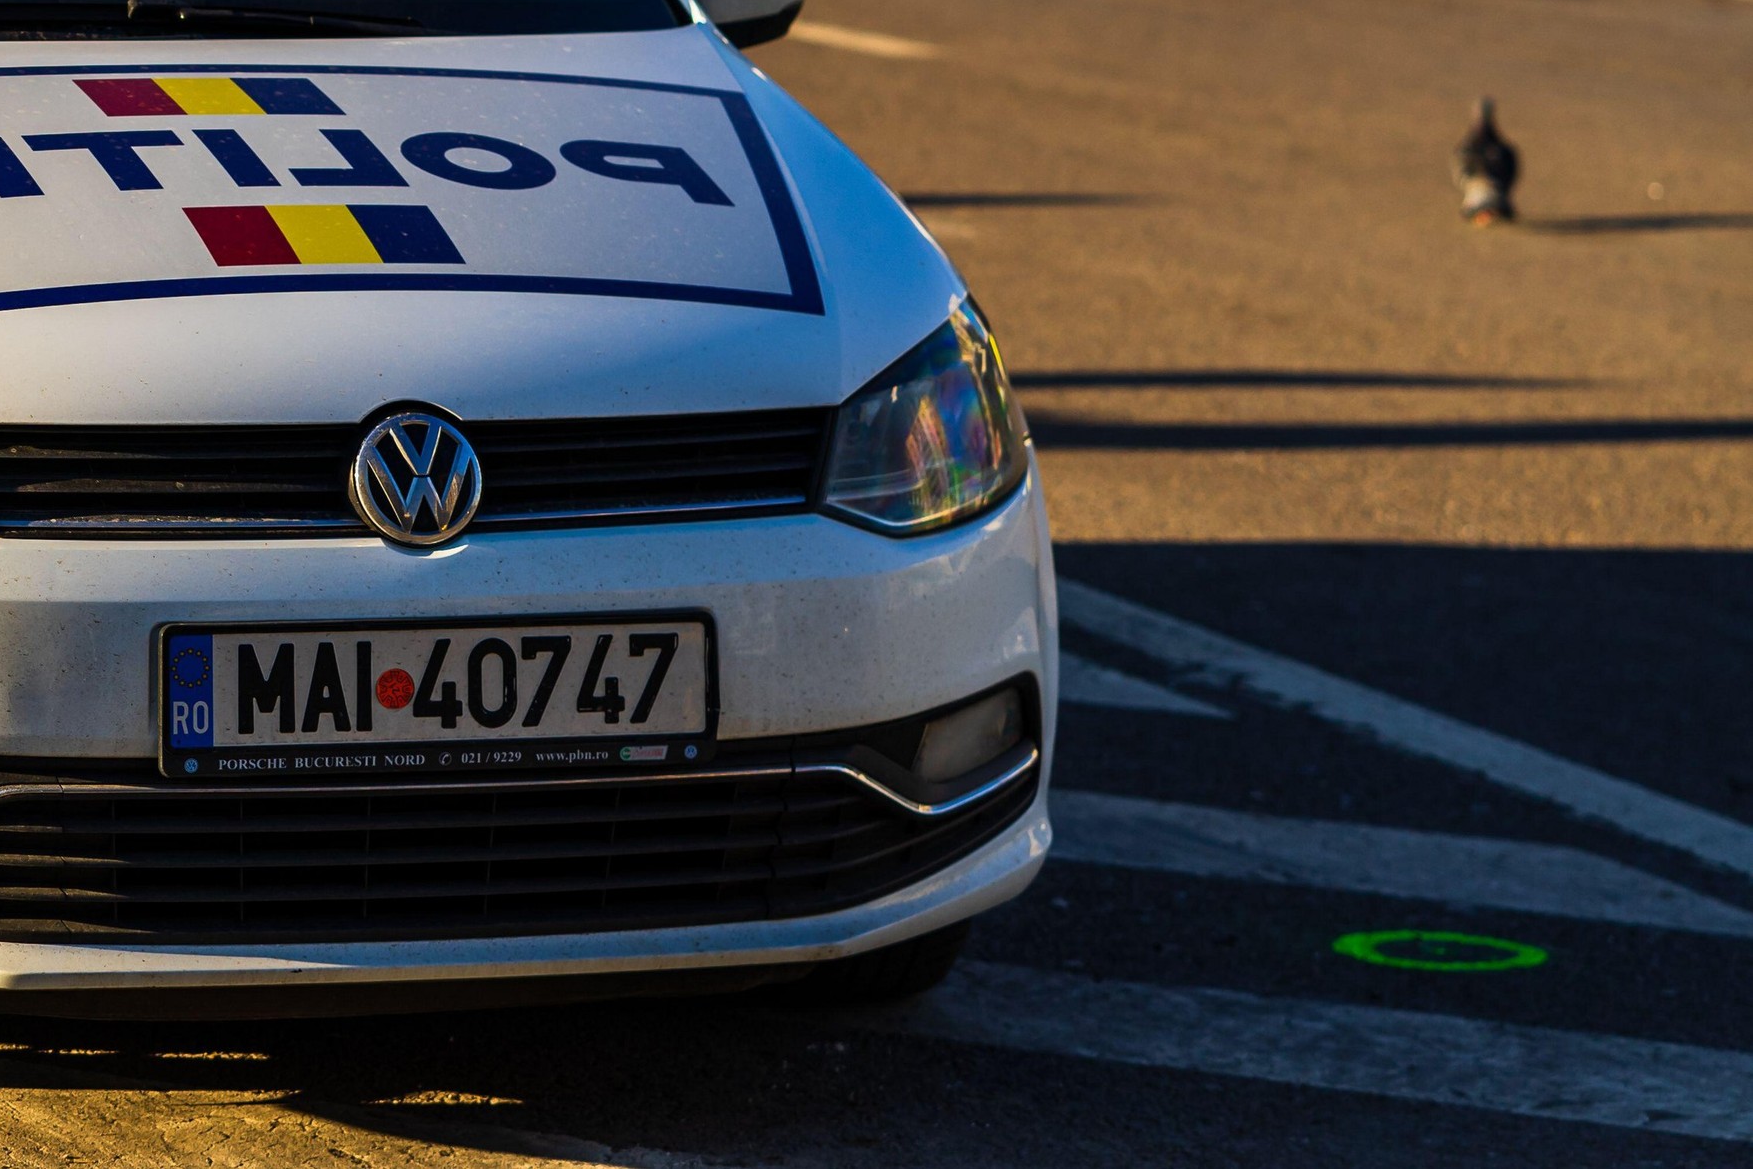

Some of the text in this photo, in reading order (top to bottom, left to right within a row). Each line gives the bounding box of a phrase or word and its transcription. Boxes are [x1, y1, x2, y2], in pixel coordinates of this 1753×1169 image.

[238, 632, 679, 735] MAI 40747
[173, 700, 209, 735] RO
[218, 757, 287, 770] PORSCHE
[295, 755, 376, 769] BUCURESTI
[384, 754, 425, 767] NORD
[461, 752, 481, 764] 021
[493, 751, 522, 763] 9229
[536, 748, 609, 763] www.pbn.ro
